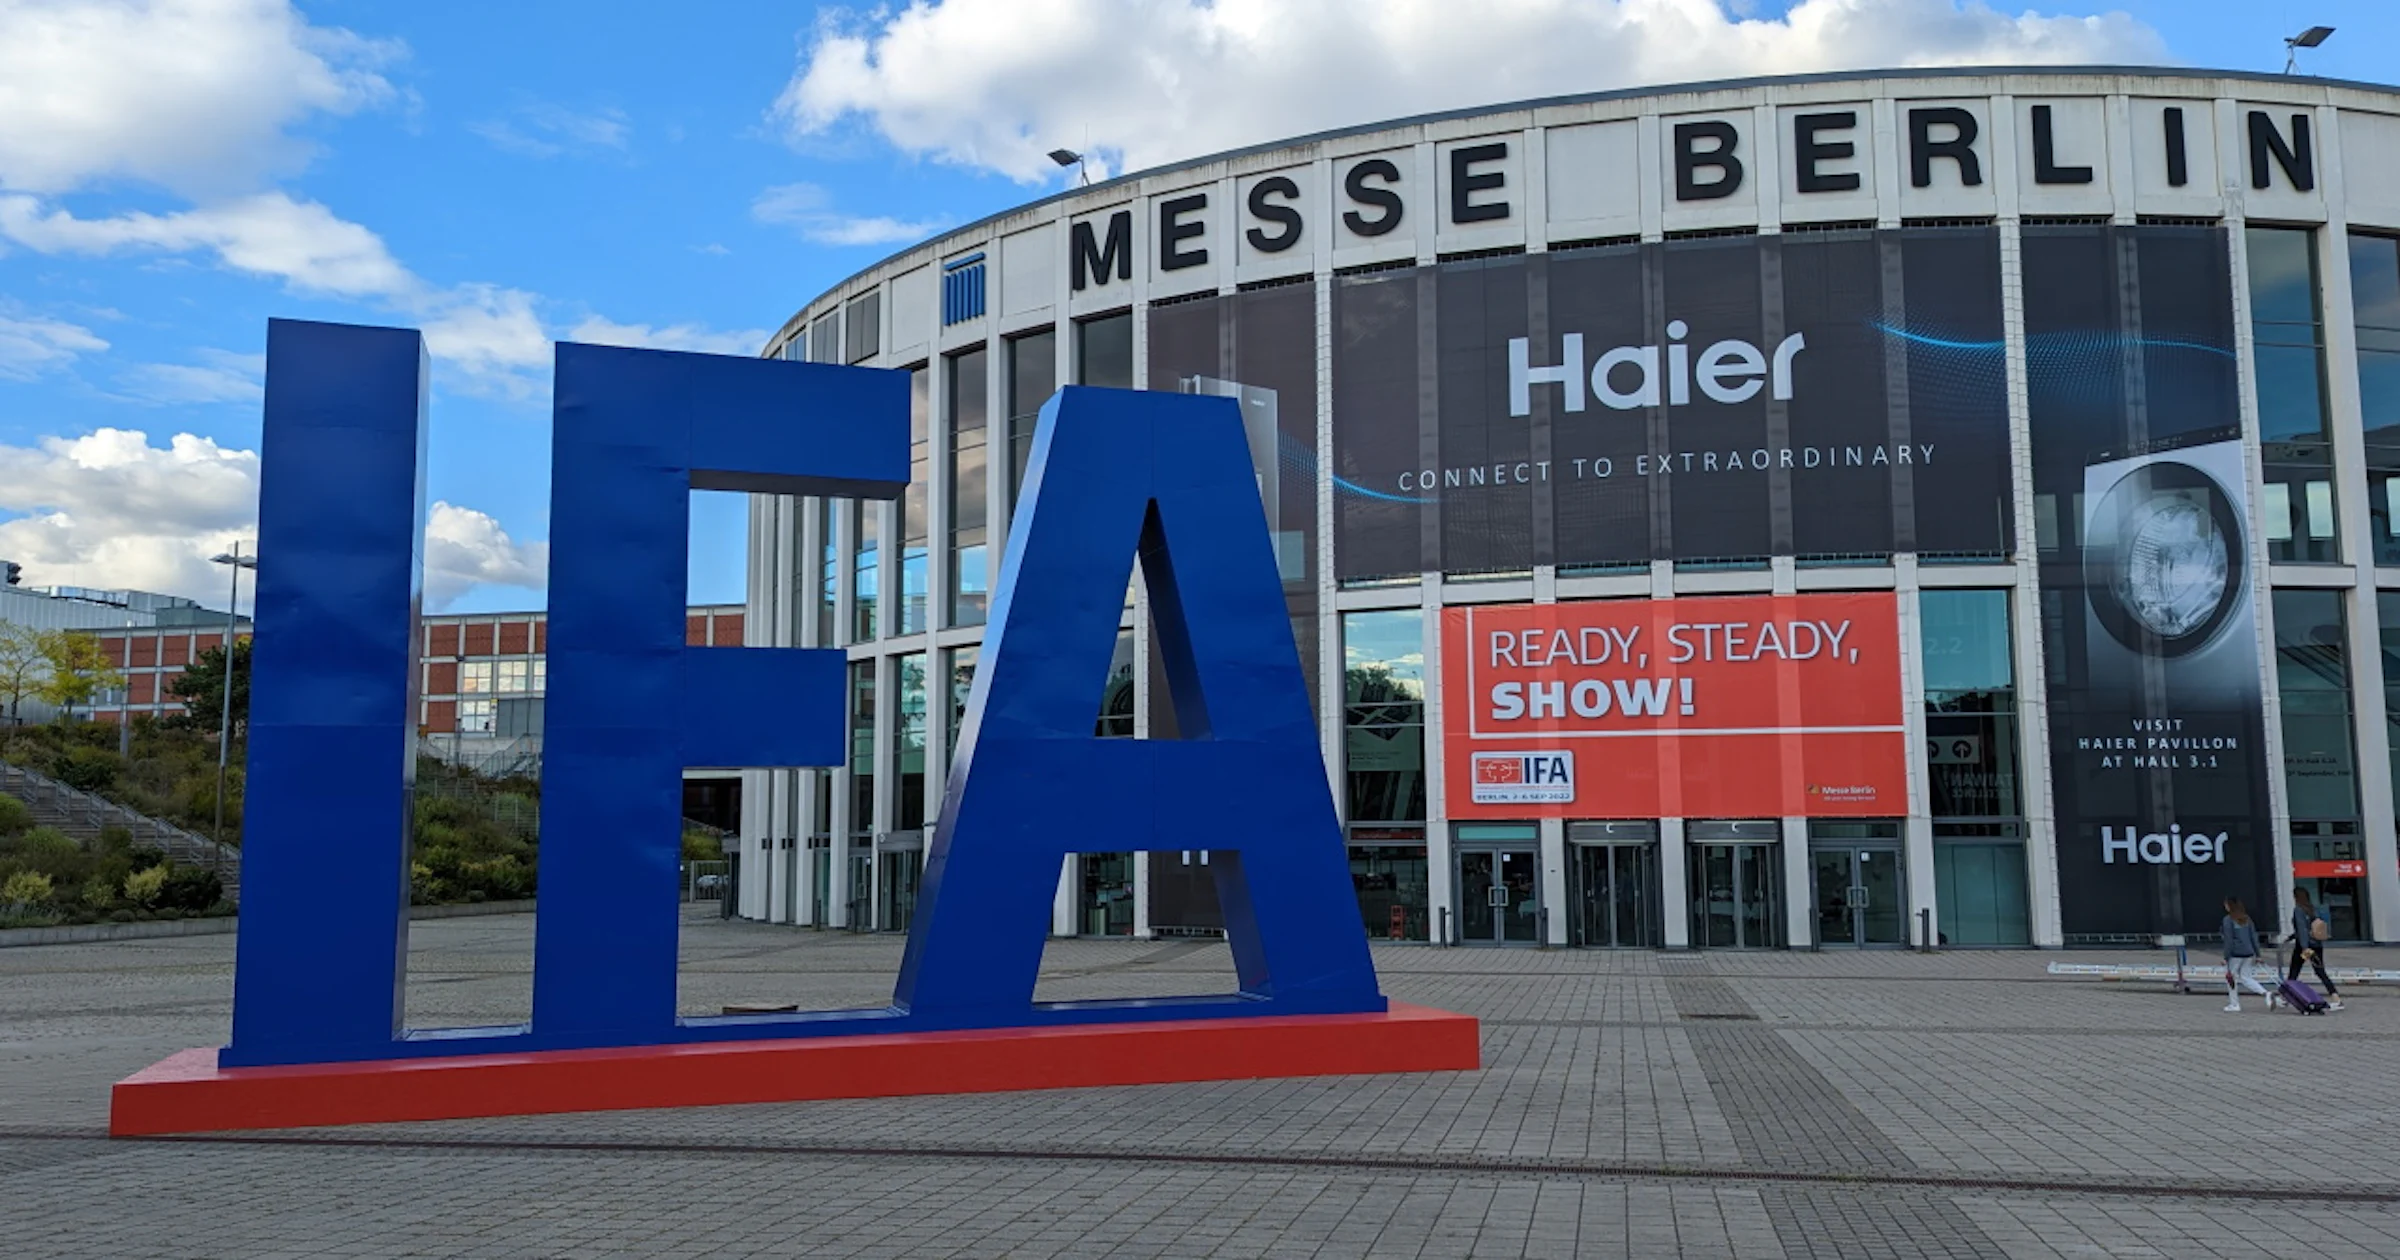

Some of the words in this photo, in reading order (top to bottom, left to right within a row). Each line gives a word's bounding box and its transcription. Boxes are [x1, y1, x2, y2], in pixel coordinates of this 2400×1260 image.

[1071, 141, 1510, 292] MESSE
[1673, 104, 2316, 202] BERLIN
[1508, 319, 1805, 417] Haier
[1398, 460, 1552, 491] CONNECT
[1573, 458, 1613, 479] TO
[1635, 444, 1937, 476] EXTRAORDINARY
[1490, 624, 1649, 669] READY,
[1666, 618, 1860, 665] STEADY,
[222, 317, 1386, 1068] IFA
[1490, 677, 1696, 721] SHOW!
[2078, 737, 2137, 749] HAIER
[2147, 737, 2237, 749] PAVILLON
[2132, 719, 2183, 731] VISIT
[1524, 757, 1569, 784] IFA
[2101, 756, 2124, 768] AT
[2134, 756, 2180, 768] HALL
[2189, 755, 2218, 768] 3.1
[2101, 823, 2229, 864] Haier
